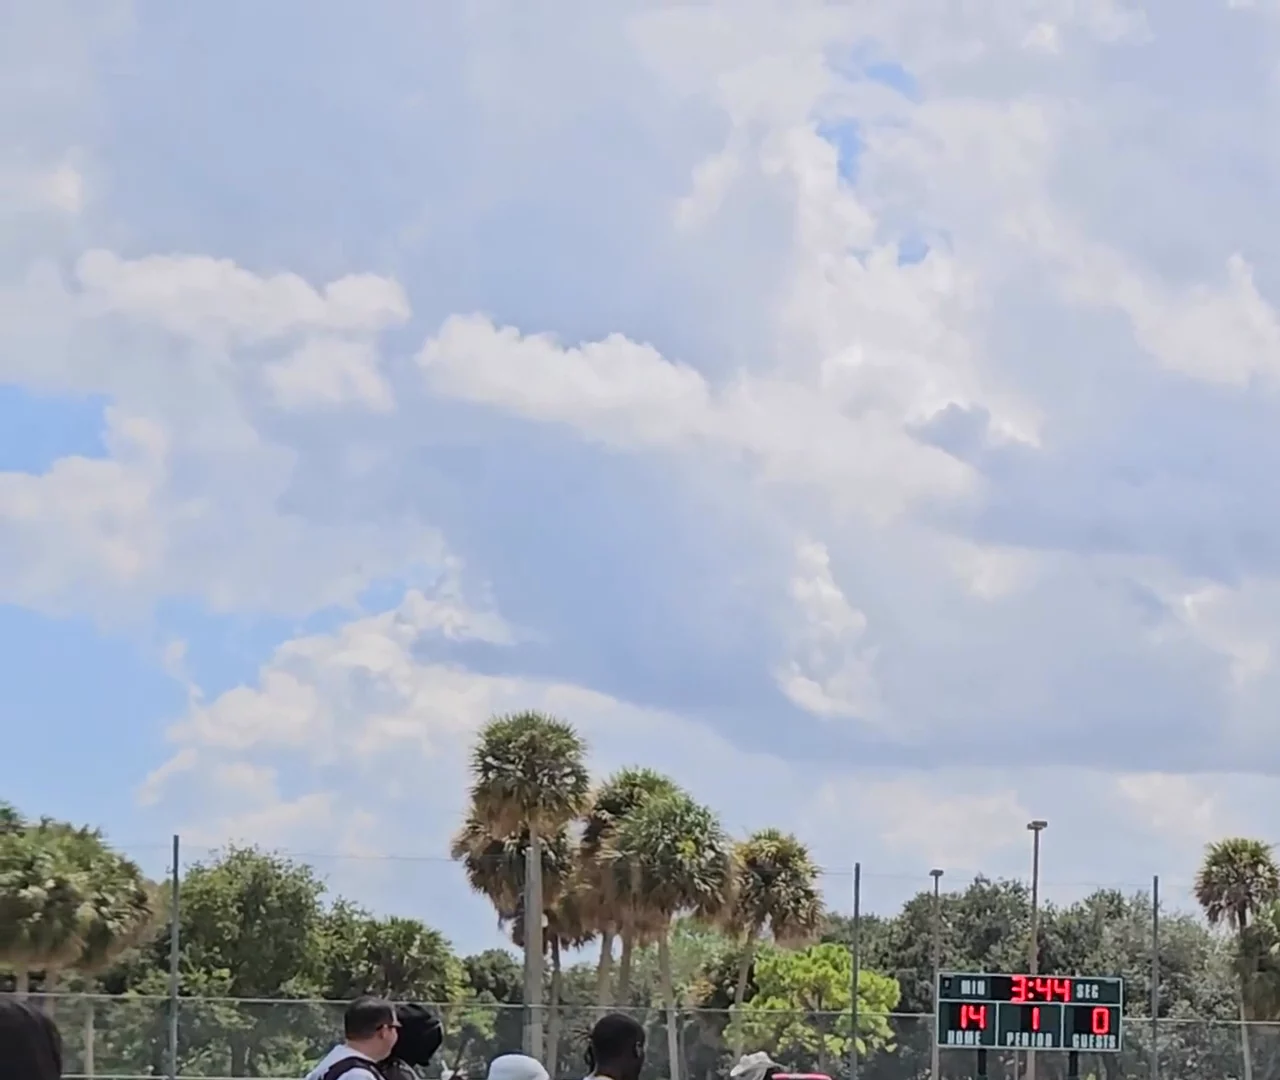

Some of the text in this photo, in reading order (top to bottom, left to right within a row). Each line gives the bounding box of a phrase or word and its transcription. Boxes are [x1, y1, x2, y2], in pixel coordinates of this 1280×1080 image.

[1011, 975, 1072, 1003] 3:44
[960, 1005, 986, 1030] 14
[1031, 1006, 1041, 1031] 1
[1092, 1006, 1110, 1034] 0
